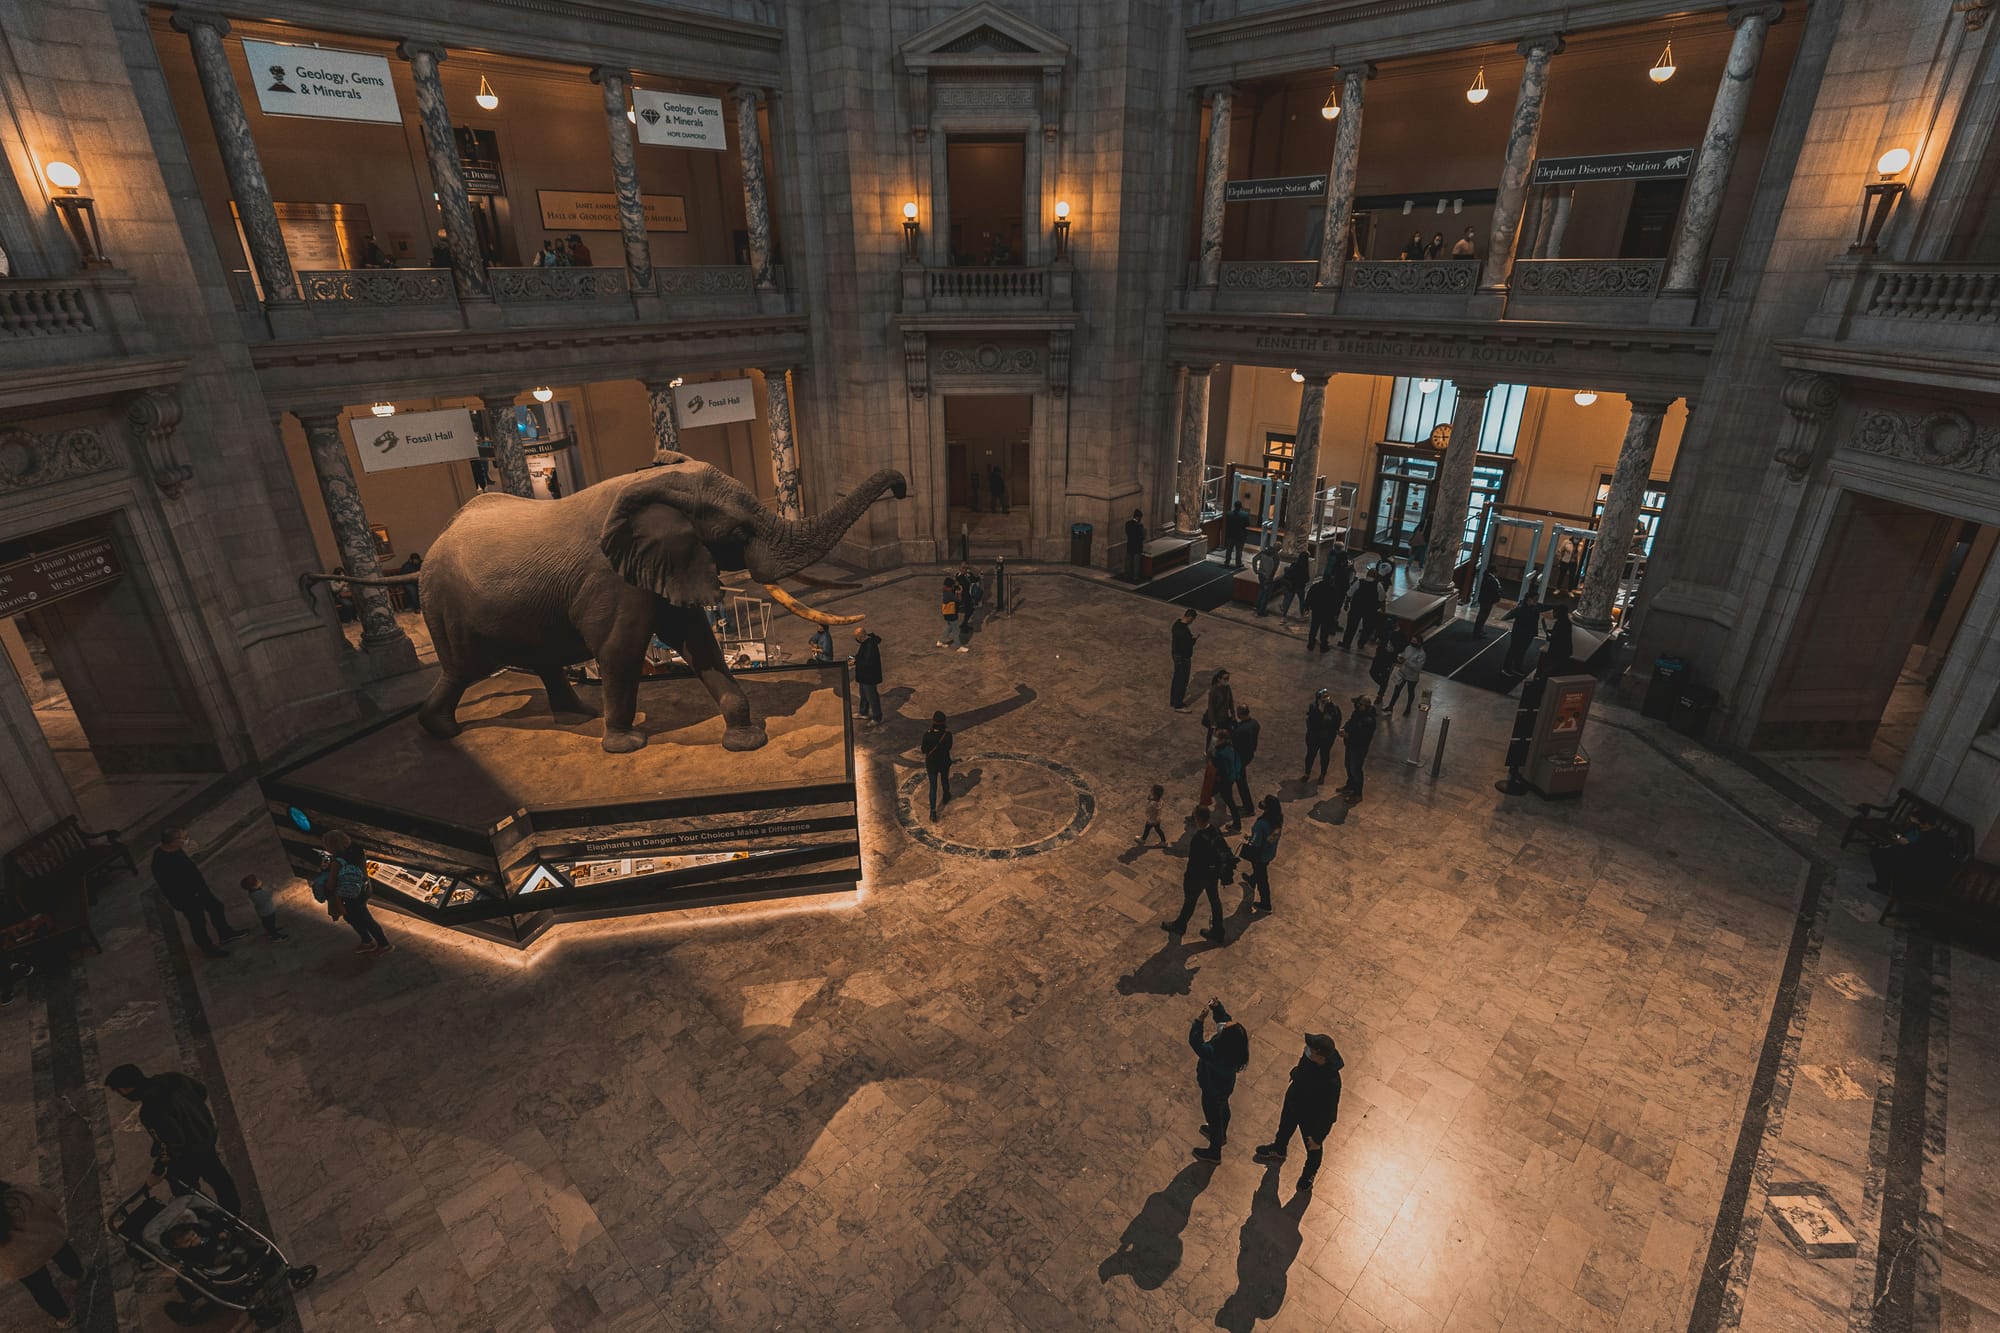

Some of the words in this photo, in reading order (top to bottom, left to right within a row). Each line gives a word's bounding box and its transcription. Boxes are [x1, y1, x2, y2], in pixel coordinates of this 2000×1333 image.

[296, 66, 348, 84] Geology,
[351, 73, 384, 86] Gems
[301, 83, 310, 94] &
[313, 84, 361, 99] Minerals
[664, 102, 697, 116] Geology,
[697, 106, 718, 116] Gems
[666, 115, 672, 124] &
[673, 116, 703, 127] Minerals
[1537, 166, 1576, 179] Elephant
[1578, 163, 1622, 176] Discovery
[1625, 160, 1660, 172] Station
[1285, 183, 1307, 193] Station
[1256, 336, 1317, 351] KENNETH
[1338, 340, 1402, 354] BEHRING
[1408, 343, 1466, 359] FAMILY
[1471, 347, 1557, 364] ROTUNDA
[708, 398, 726, 408] Fossil
[727, 396, 740, 405] Hall
[405, 433, 433, 444] Fossil
[434, 431, 453, 441] Hall
[586, 841, 630, 851] Elephants
[632, 839, 641, 847] in
[643, 837, 677, 846] Danger:
[701, 831, 735, 840] Choices
[737, 828, 759, 836] Make
[768, 824, 810, 833] Difference
